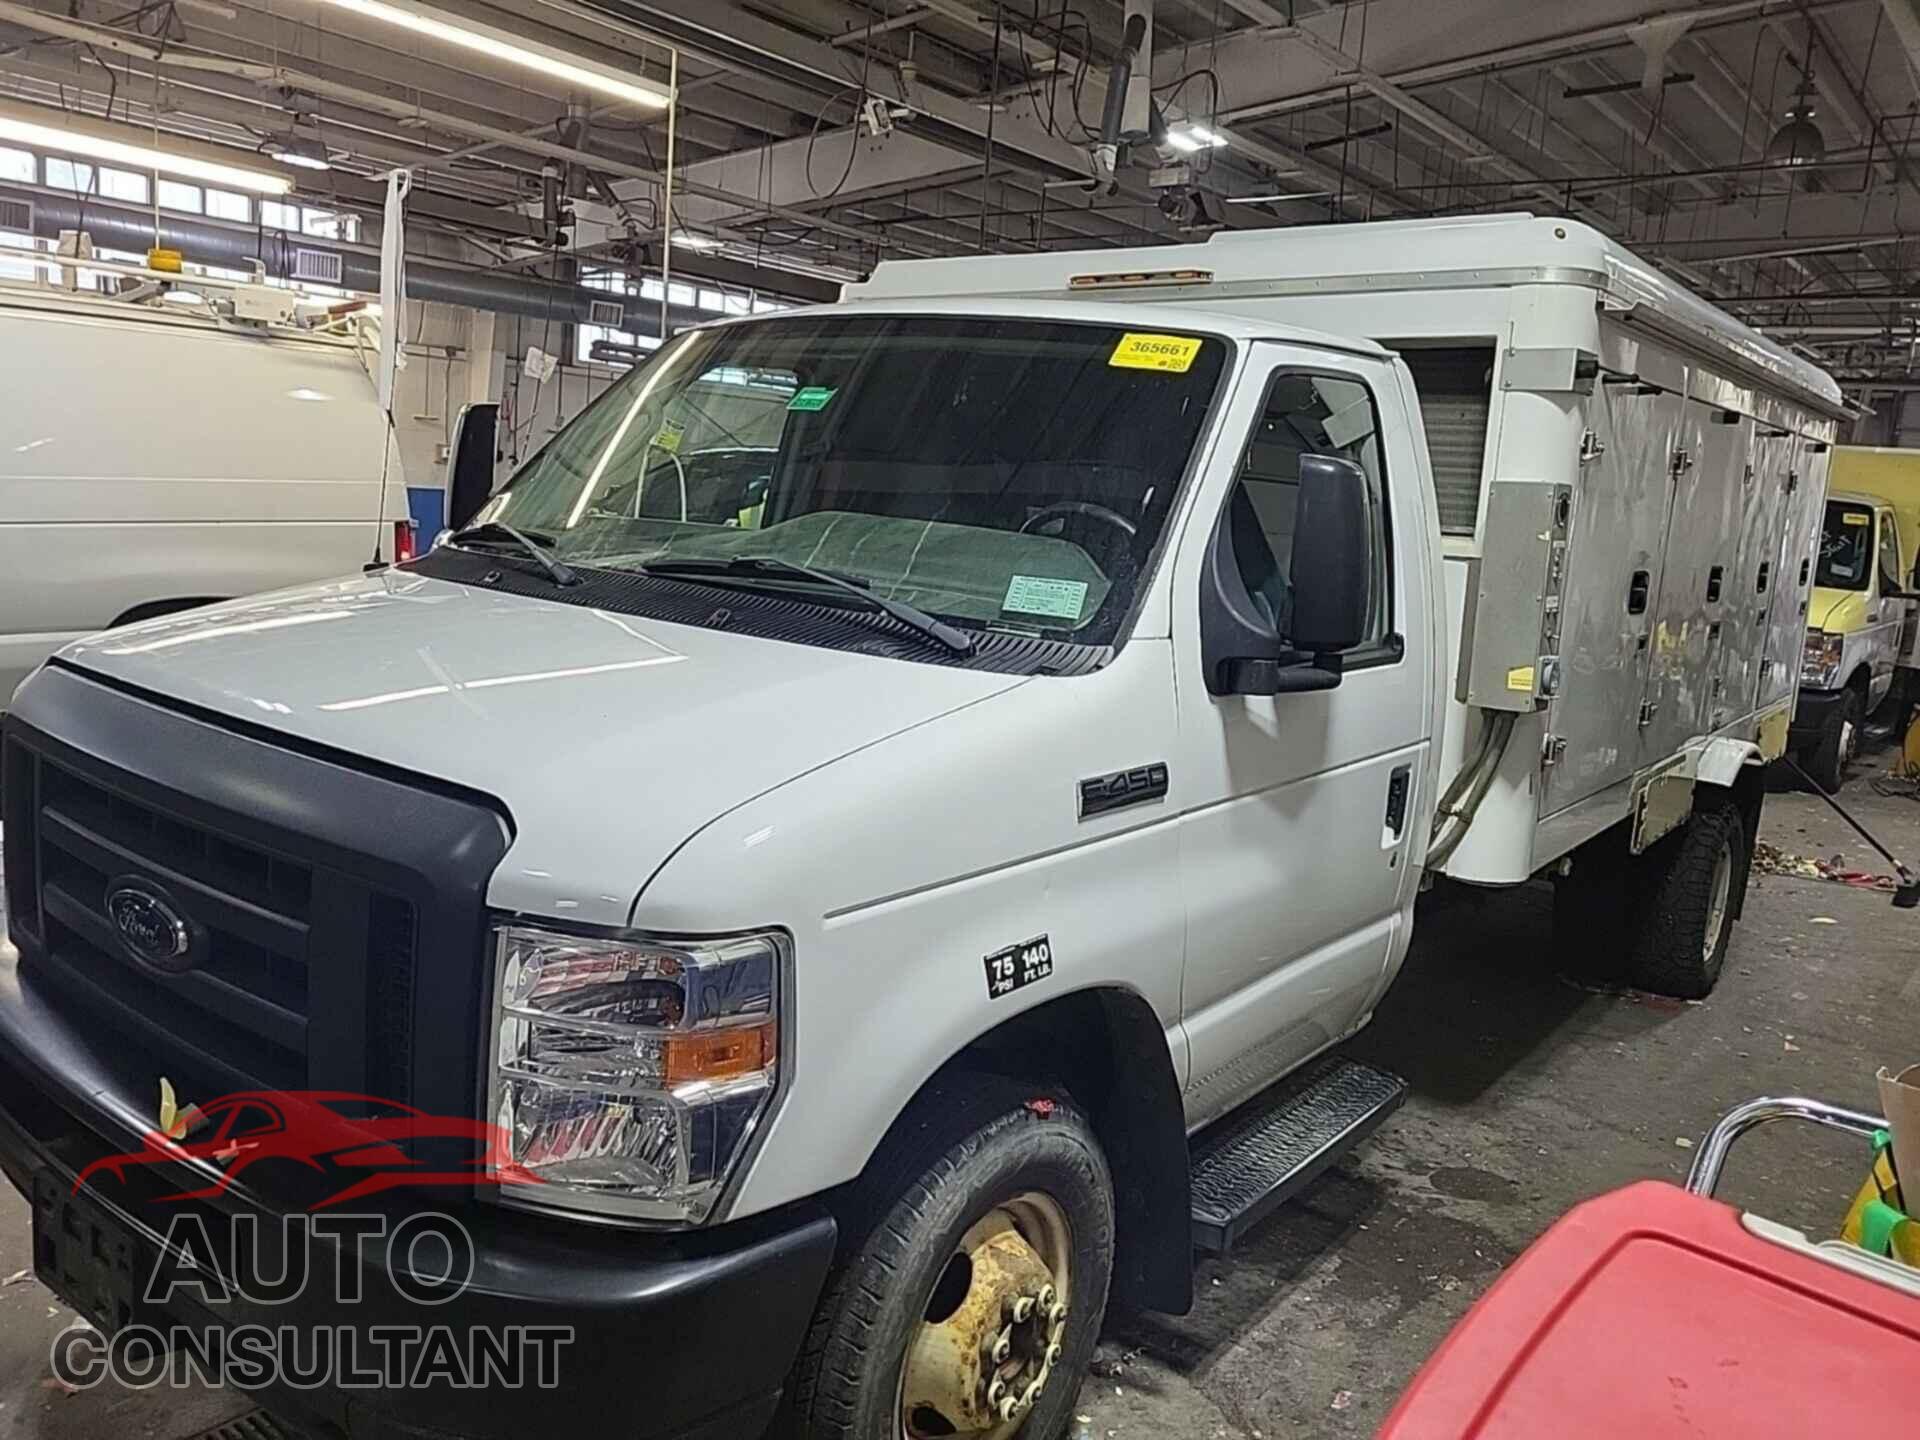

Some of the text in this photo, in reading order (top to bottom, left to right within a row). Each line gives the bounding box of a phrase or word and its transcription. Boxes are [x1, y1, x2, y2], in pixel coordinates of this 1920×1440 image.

[1129, 341, 1190, 357] 365661
[991, 955, 1015, 980] 75
[1022, 943, 1049, 969] 140
